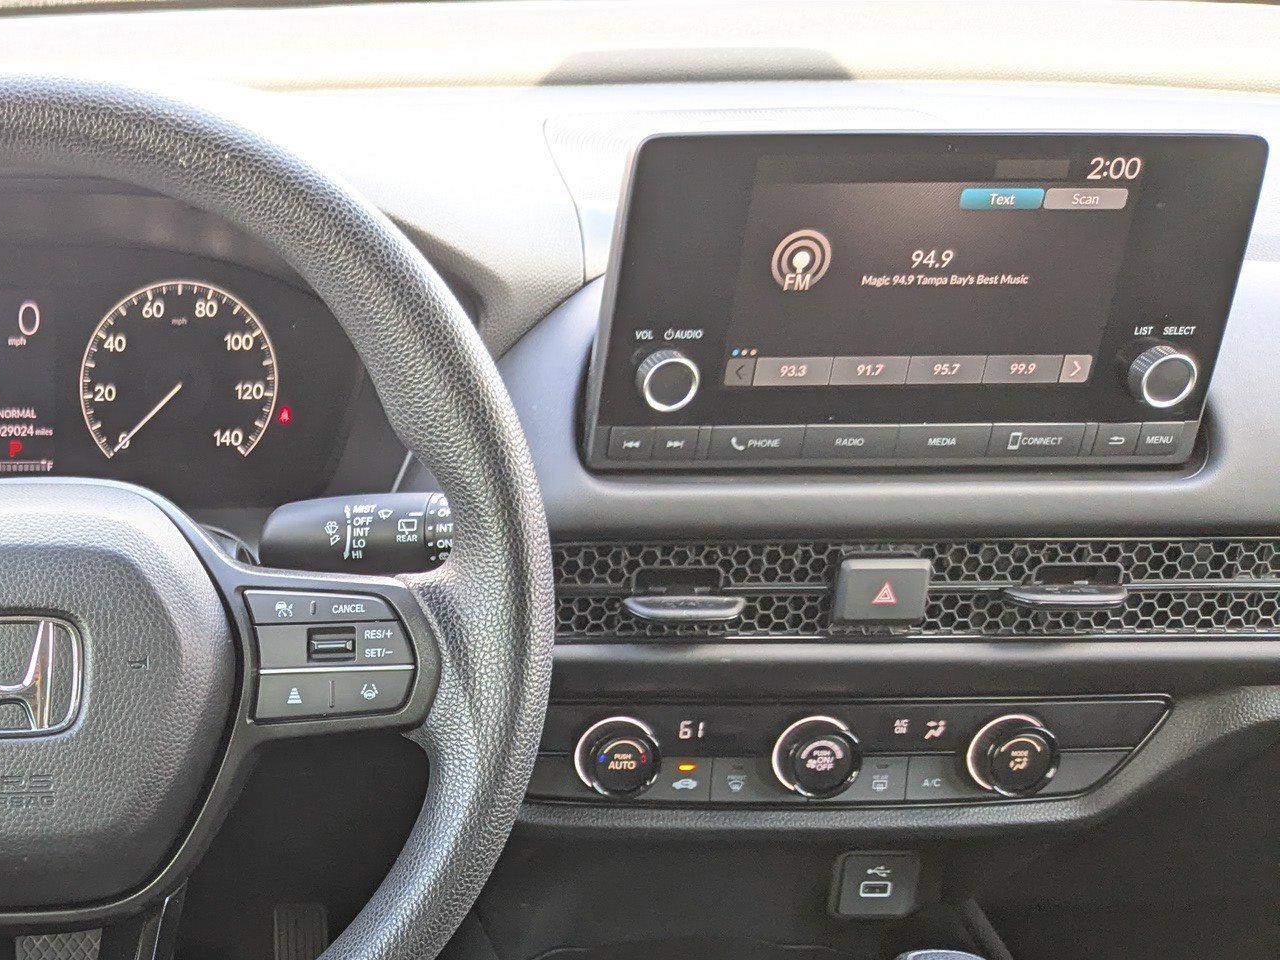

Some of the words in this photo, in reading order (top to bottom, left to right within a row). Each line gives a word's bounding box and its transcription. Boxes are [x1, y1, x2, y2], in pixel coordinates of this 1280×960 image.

[1086, 156, 1142, 180] 2:00
[989, 193, 1016, 206] Text
[1071, 193, 1099, 206] Scan
[911, 250, 954, 269] 94.9
[783, 274, 812, 291] FM
[861, 275, 891, 288] Magic
[891, 275, 915, 286] 94.9
[917, 275, 949, 287] Tampa
[950, 275, 974, 287] Bay's
[976, 274, 999, 285] Best
[1000, 274, 1029, 285] Music
[142, 300, 164, 318] 60
[195, 300, 218, 318] 80
[18, 302, 40, 336] 0
[635, 330, 654, 340] VOL
[674, 329, 704, 340] AUDIO
[1134, 326, 1154, 336] LIST
[1163, 326, 1197, 336] SELECT
[7, 337, 27, 347] mph
[104, 334, 127, 352] 40
[223, 333, 253, 351] 100
[780, 364, 808, 377] 93.3
[856, 364, 885, 377] 91.7
[933, 363, 960, 376] 95.7
[1009, 362, 1037, 375] 99.9
[94, 383, 116, 402] 20
[234, 382, 265, 400] 120
[35, 427, 53, 436] miles
[213, 429, 243, 447] 140
[747, 438, 782, 448] PHONE
[835, 437, 865, 447] RADIO
[927, 437, 957, 446] MEDIA
[1021, 436, 1063, 446] CONNECT
[1145, 435, 1174, 445] MENU
[9, 440, 23, 457] P
[352, 504, 377, 514] MIST
[353, 516, 373, 526] OFF
[353, 527, 370, 537] INT
[436, 523, 454, 533] INT
[396, 534, 418, 542] REAR
[352, 539, 366, 548] LO
[436, 539, 453, 548] ON
[351, 550, 363, 559] HI
[332, 604, 366, 614] CANCEL
[894, 718, 910, 727] A/C
[678, 719, 705, 740] 61
[608, 760, 637, 770] AUTO
[816, 763, 834, 771] OFF
[922, 778, 942, 788] A/C
